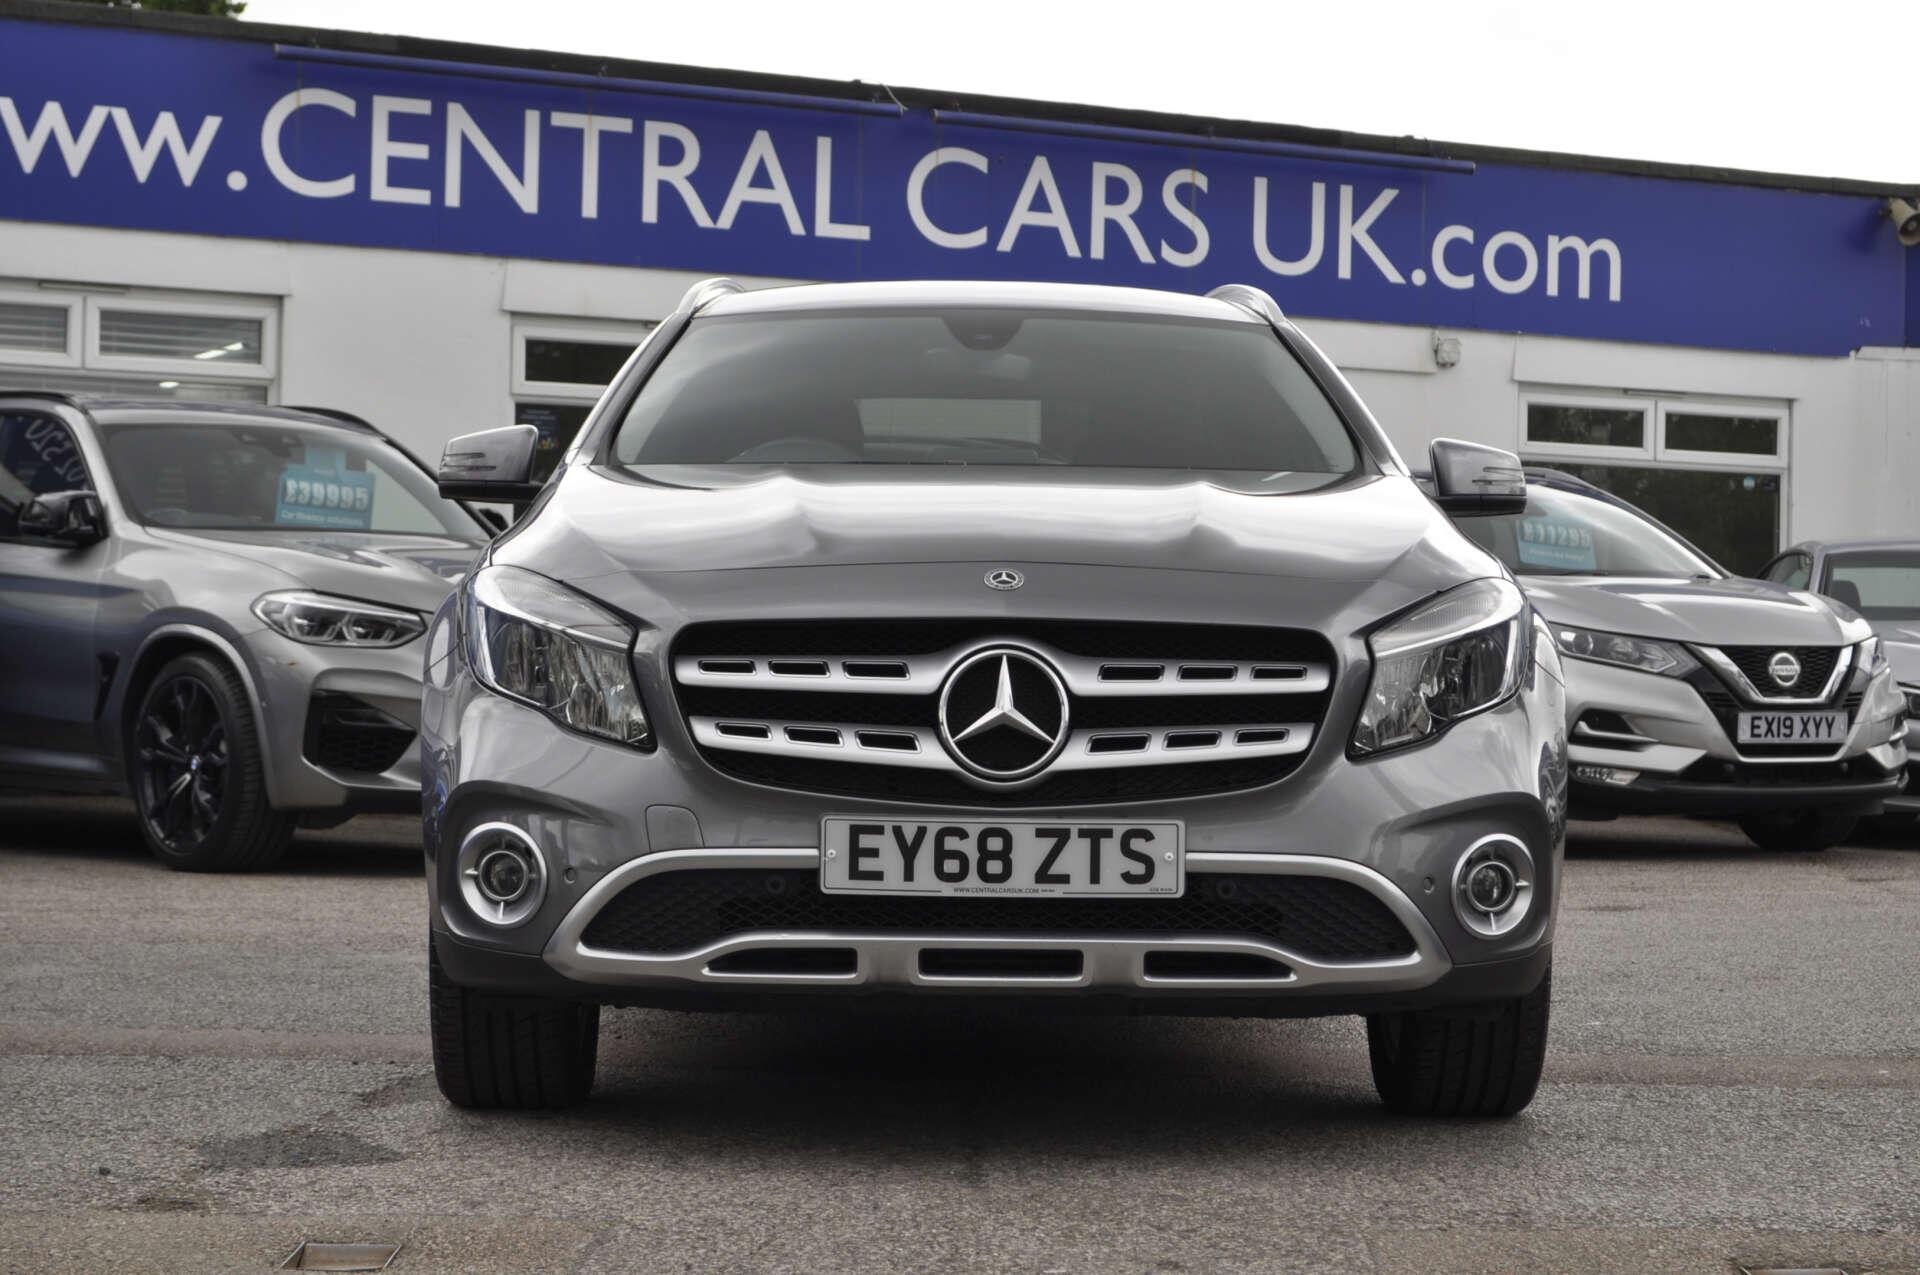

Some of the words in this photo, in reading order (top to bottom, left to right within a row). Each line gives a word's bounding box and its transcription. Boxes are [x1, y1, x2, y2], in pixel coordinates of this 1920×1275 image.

[906, 147, 1210, 268] CARS
[1253, 176, 1622, 302] UK.com
[1750, 715, 1794, 739] EX19
[1799, 715, 1836, 738] XYY
[848, 823, 1013, 884] EY68
[1034, 827, 1156, 885] ZTS
